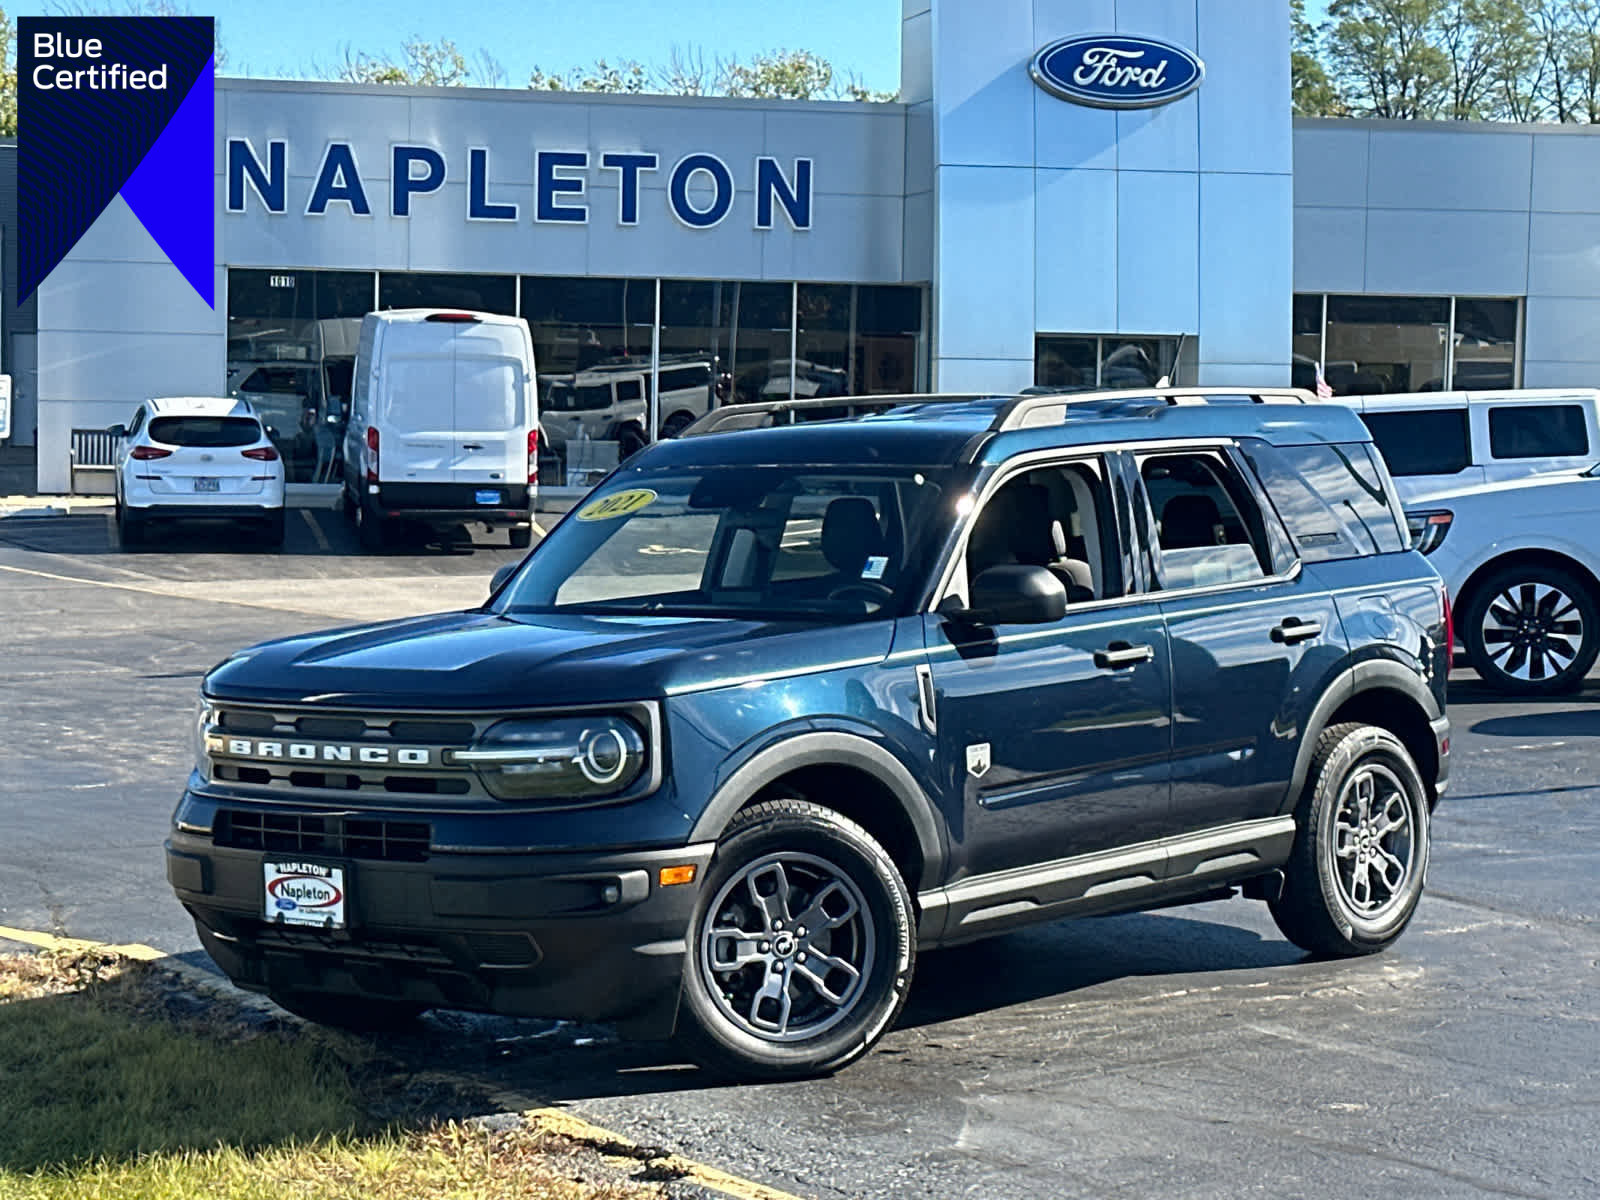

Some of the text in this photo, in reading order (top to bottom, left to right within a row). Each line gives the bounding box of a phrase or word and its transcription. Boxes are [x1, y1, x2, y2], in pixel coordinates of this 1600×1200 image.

[1073, 47, 1168, 88] Ford
[225, 137, 813, 230] NAPLETON
[584, 493, 647, 516] 2021
[229, 739, 430, 765] BRONCO
[280, 862, 328, 876] NAPLETON
[281, 882, 331, 901] Napleton
